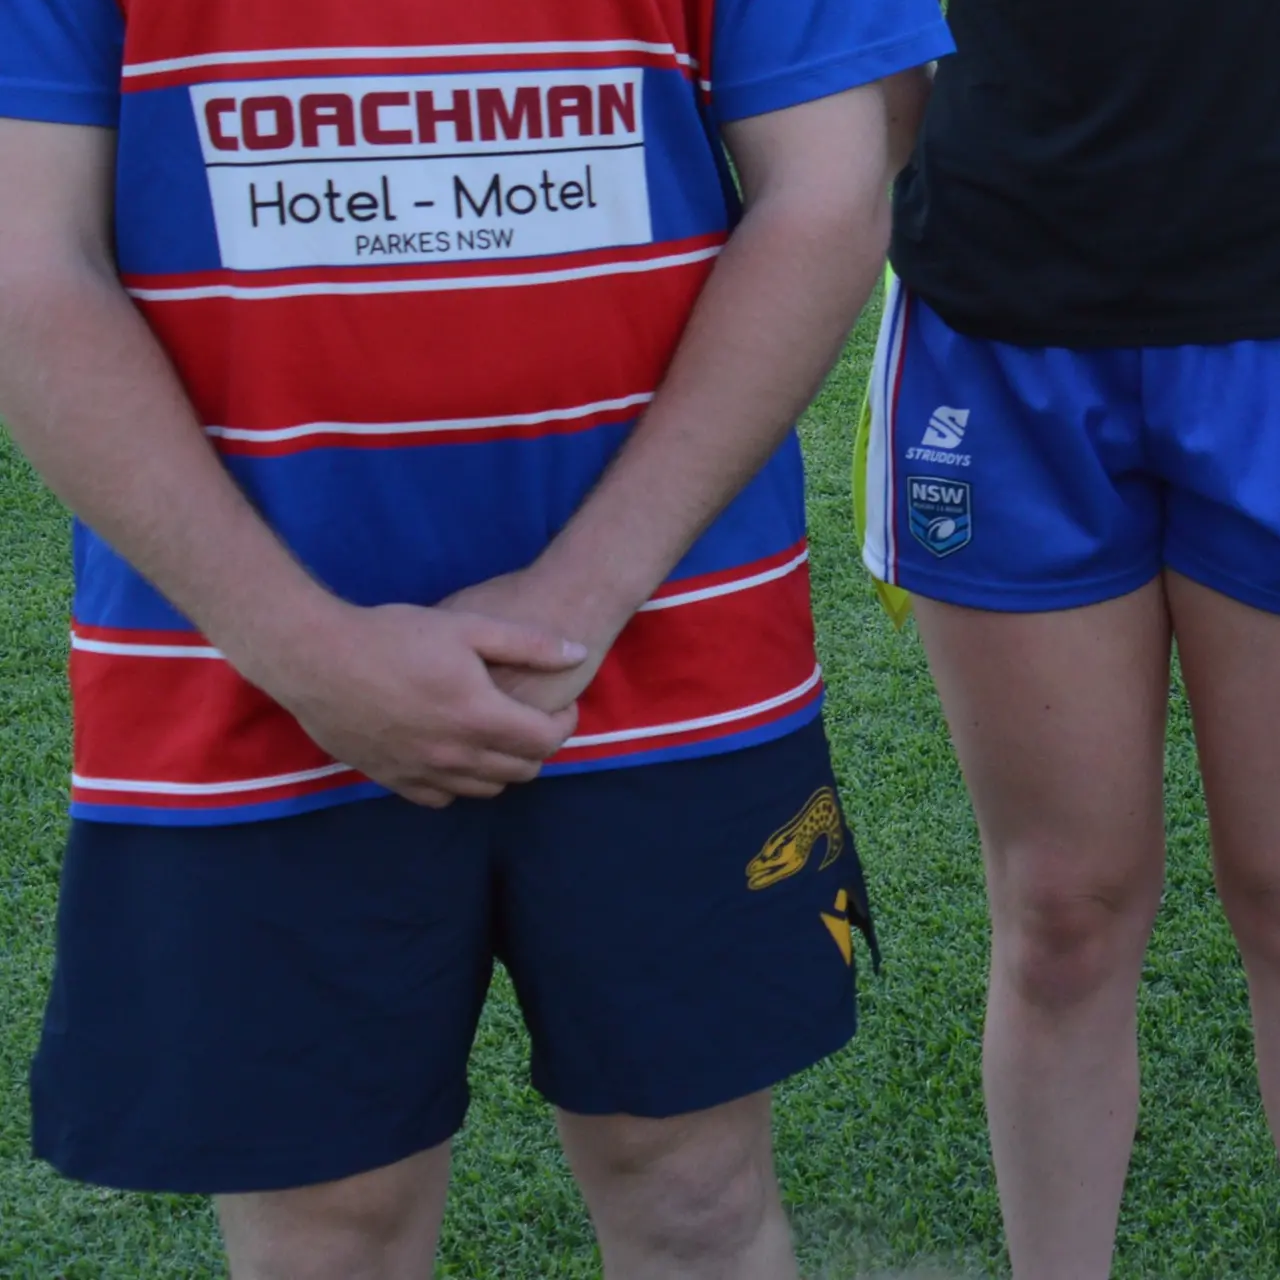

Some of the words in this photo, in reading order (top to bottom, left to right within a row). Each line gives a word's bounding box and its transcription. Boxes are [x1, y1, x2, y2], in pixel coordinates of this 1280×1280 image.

[204, 82, 636, 152] COACHMAN
[249, 174, 397, 227] Hotel
[453, 164, 597, 220] Motel
[356, 230, 451, 256] PARKES
[457, 228, 515, 252] NSW
[905, 447, 972, 467] STRUDDYS
[912, 482, 964, 505] NSW
